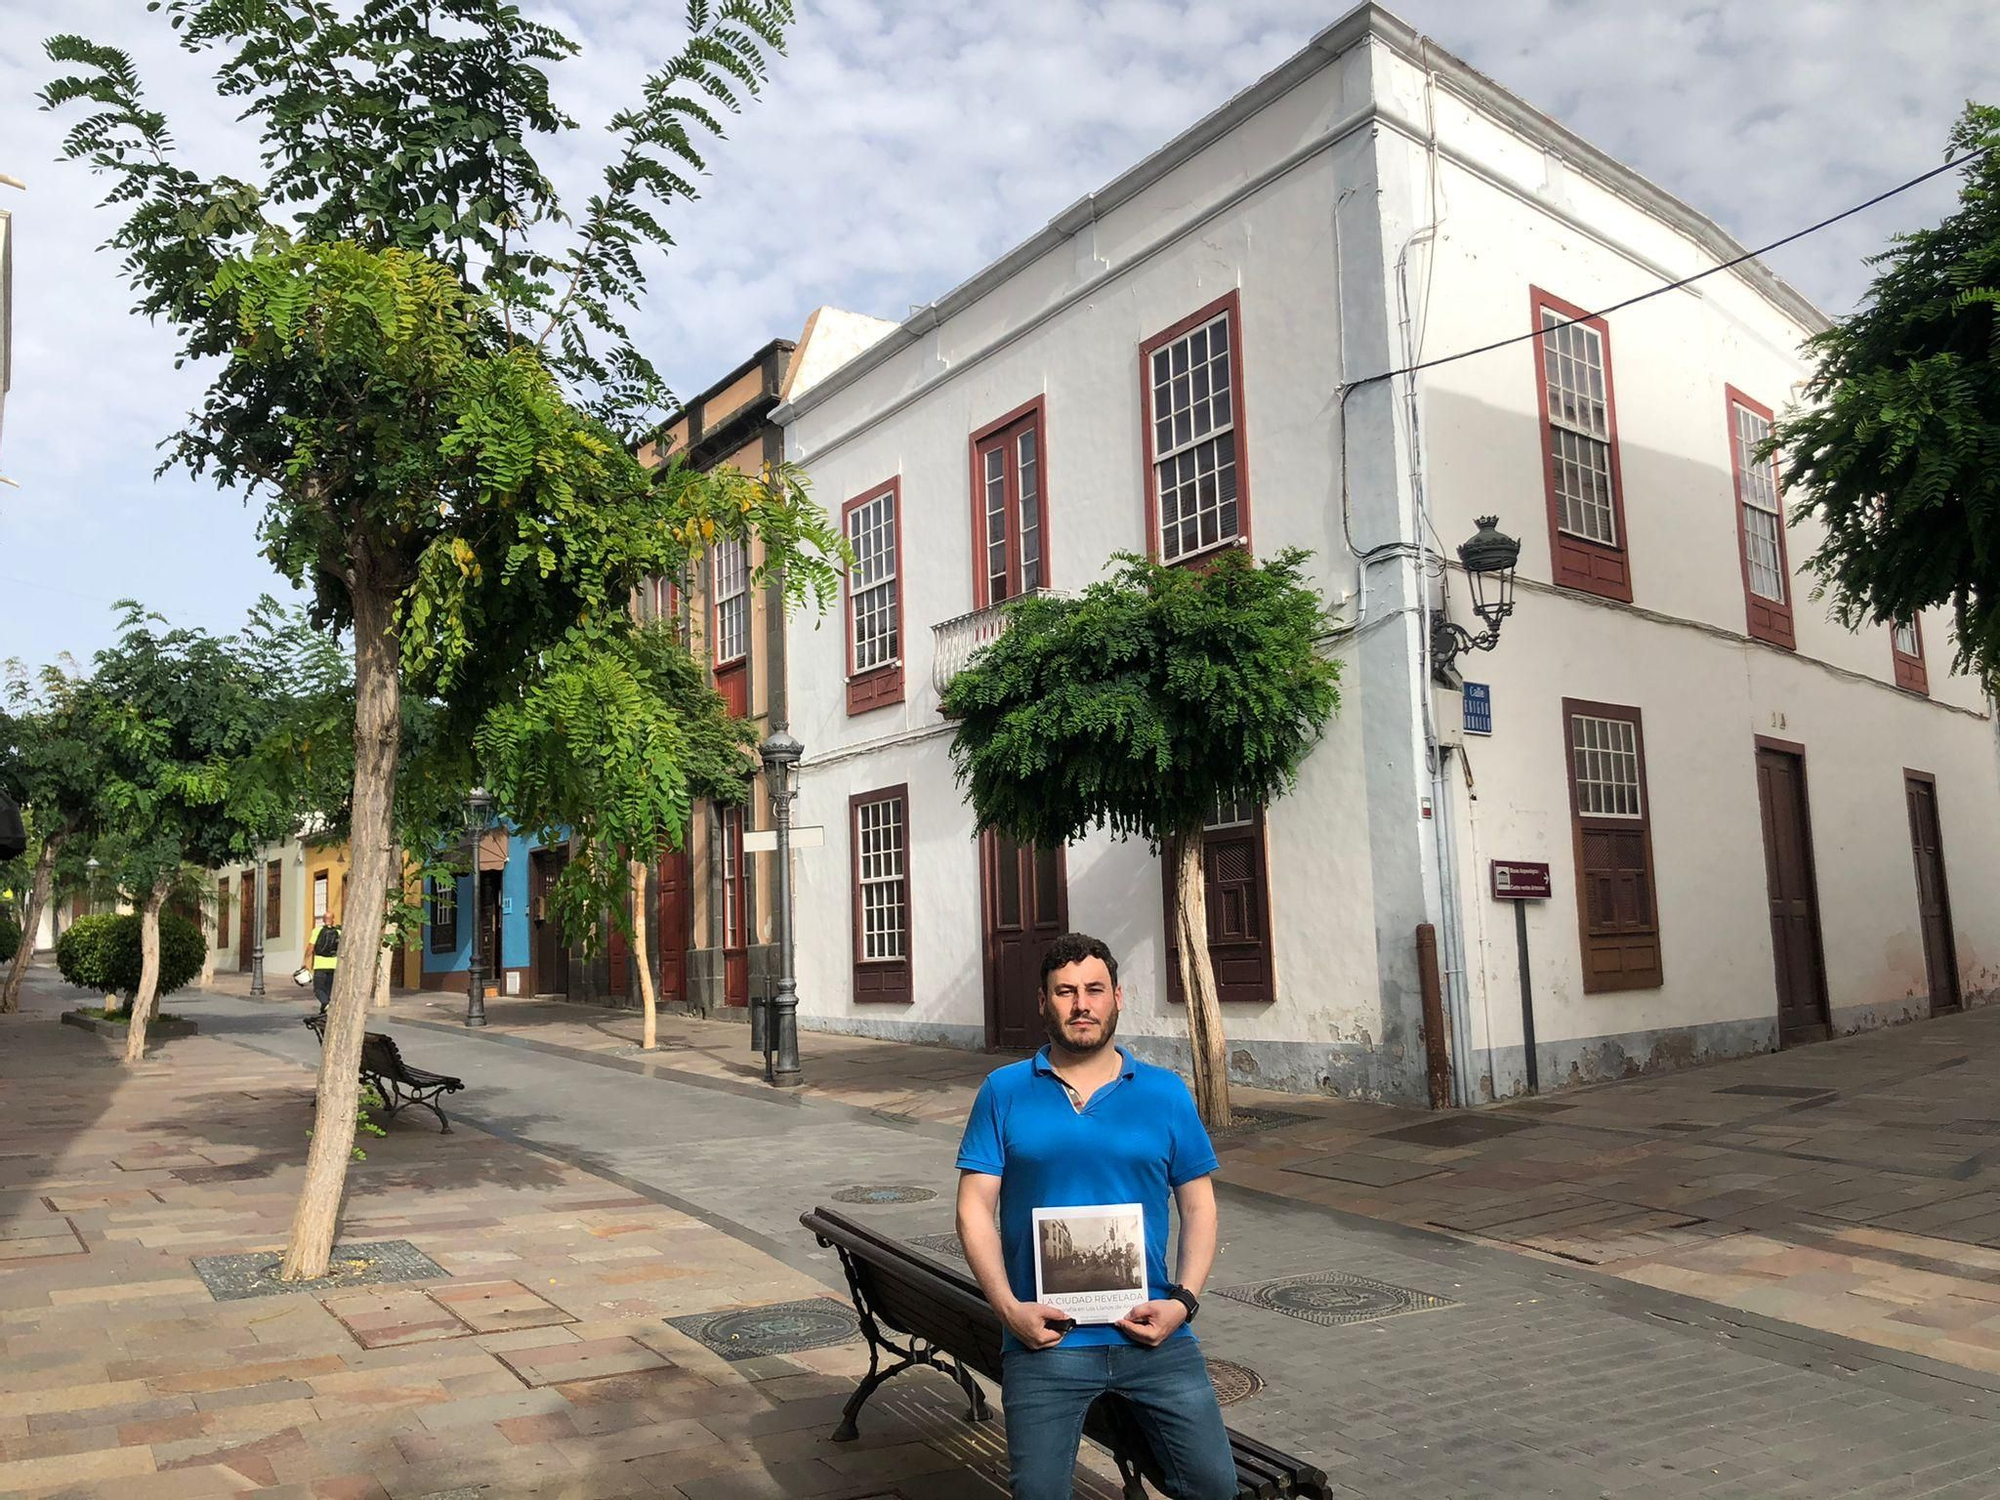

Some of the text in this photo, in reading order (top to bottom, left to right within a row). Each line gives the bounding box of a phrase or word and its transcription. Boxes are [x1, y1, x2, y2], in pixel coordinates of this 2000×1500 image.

[1042, 1292, 1144, 1306] LA CIUDAD REVELADA
